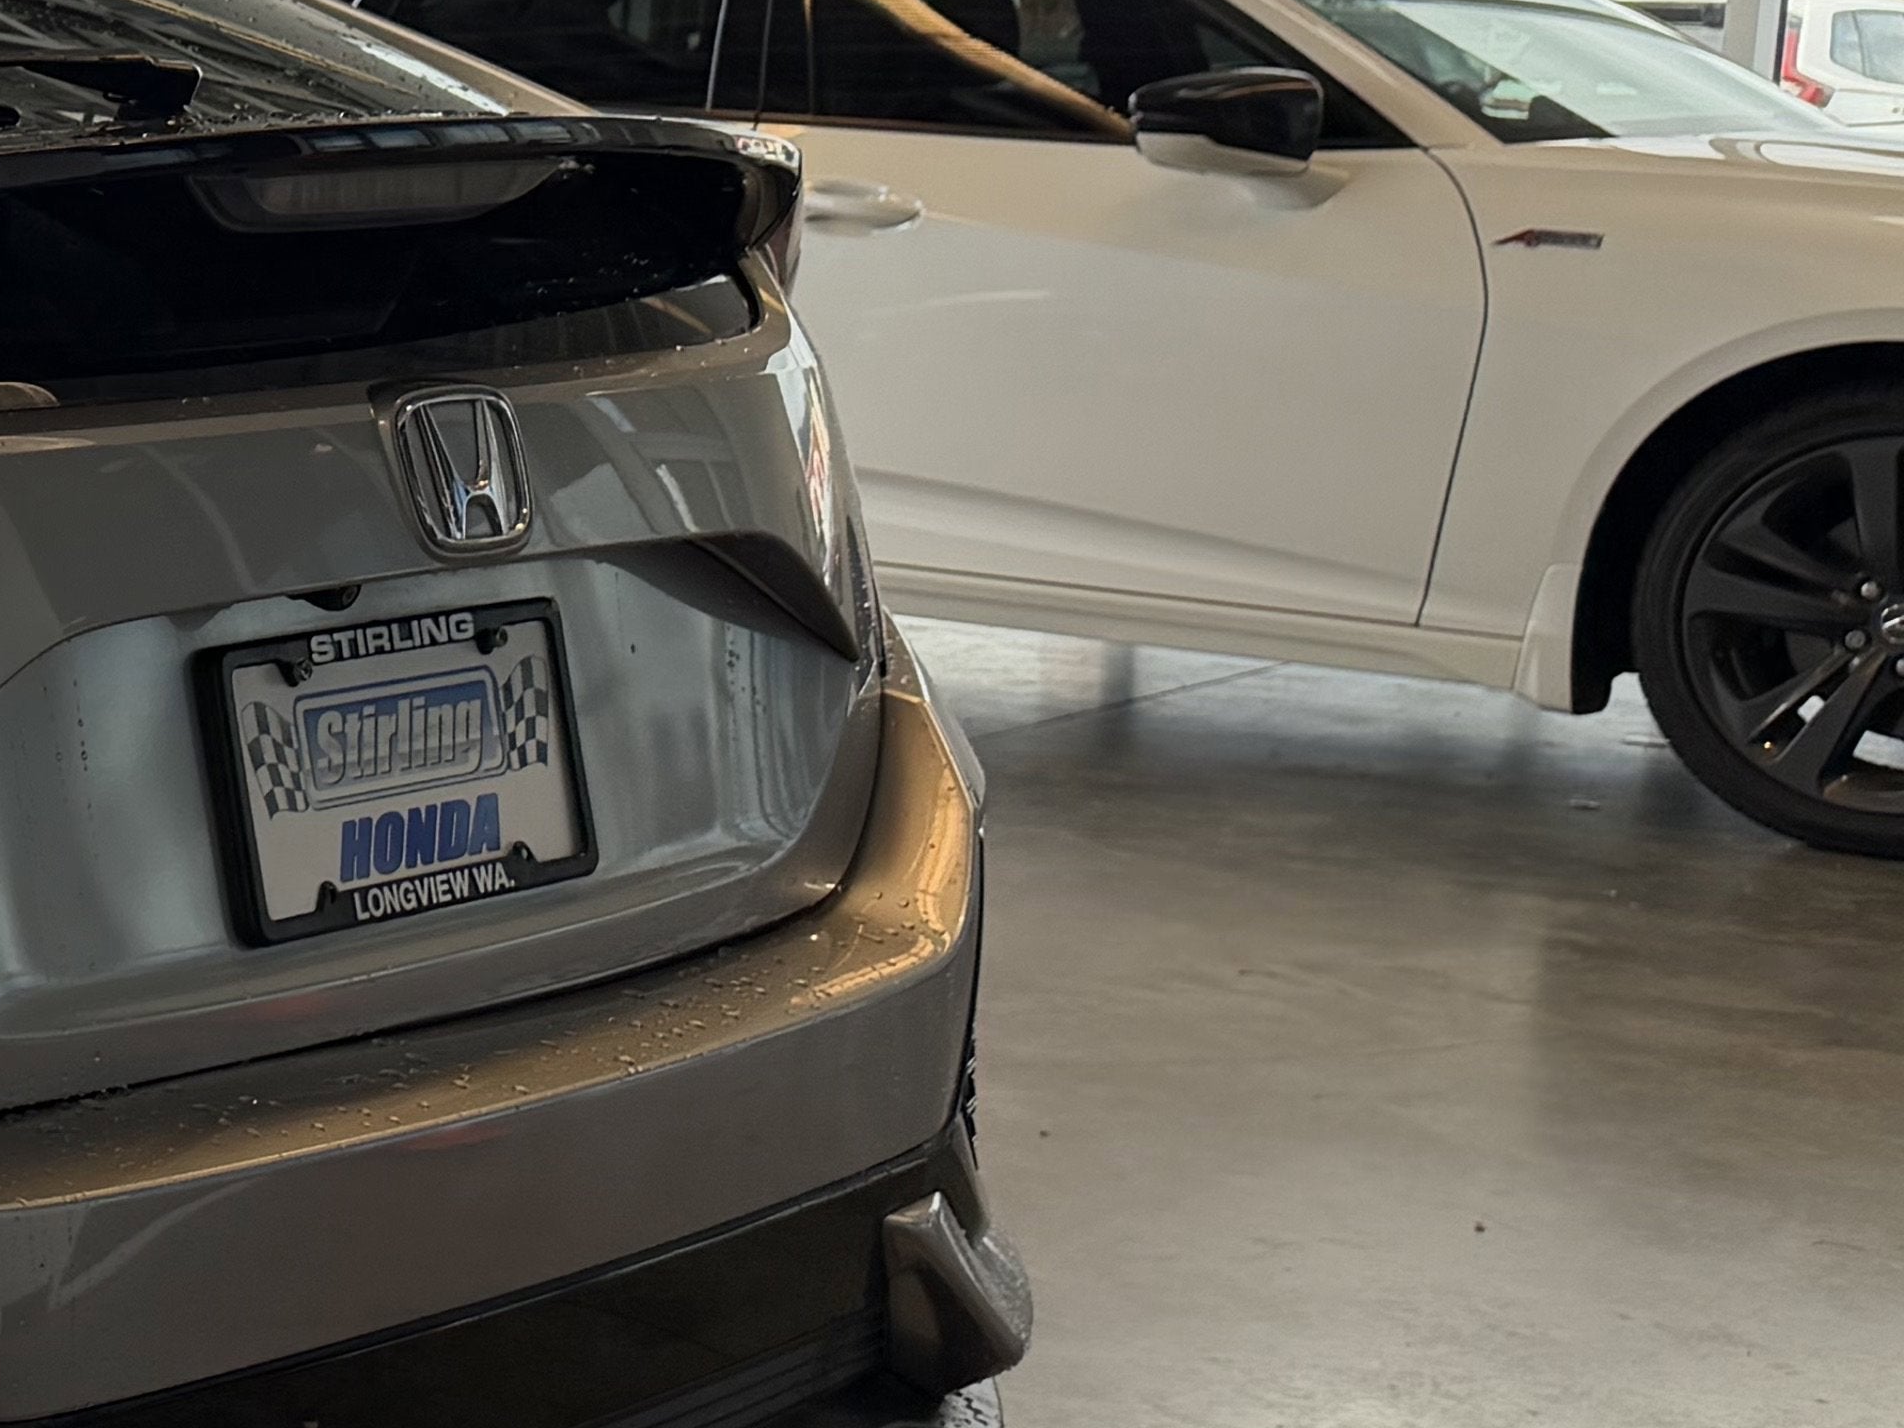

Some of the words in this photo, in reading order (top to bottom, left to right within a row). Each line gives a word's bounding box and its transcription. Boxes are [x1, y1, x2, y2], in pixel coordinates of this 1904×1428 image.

[310, 612, 475, 664] STIRLING
[315, 696, 482, 785] Stirling
[340, 793, 501, 883] HONDA
[353, 870, 471, 921] LONGVIEW
[472, 862, 515, 891] WA.
